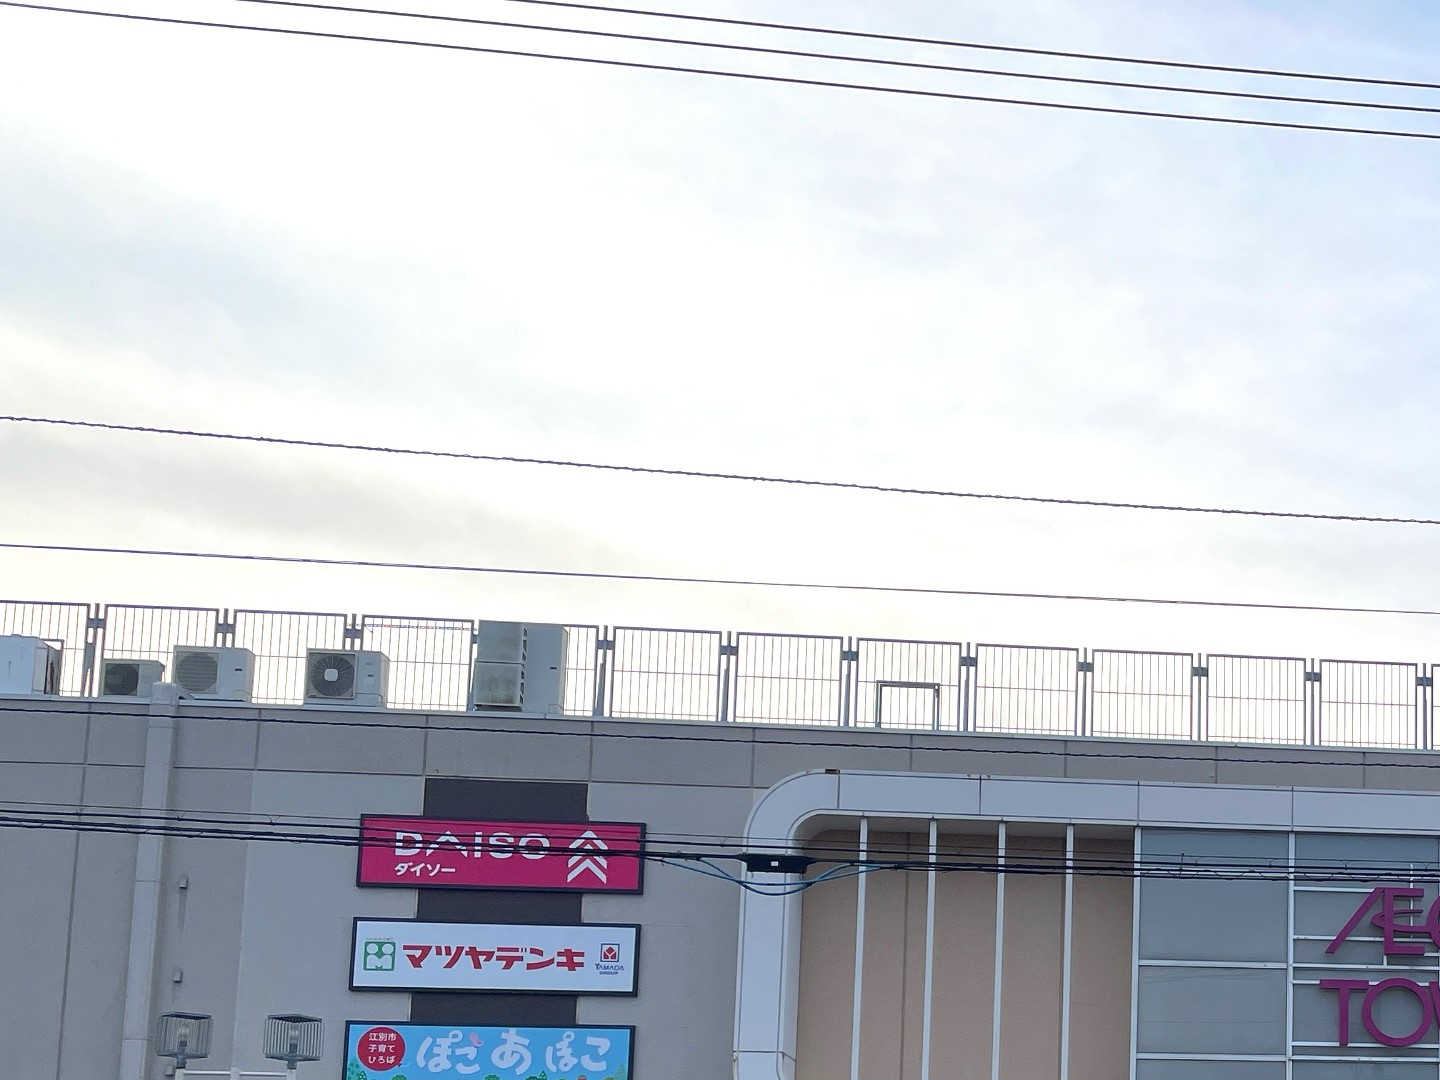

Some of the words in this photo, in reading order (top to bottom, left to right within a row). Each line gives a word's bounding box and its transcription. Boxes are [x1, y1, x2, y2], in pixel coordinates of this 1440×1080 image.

[394, 830, 550, 860] DAISO
[394, 862, 456, 877] ダイソー
[402, 944, 585, 972] マツヤデンキ
[595, 963, 624, 971] YAMADA
[368, 1032, 397, 1042] 江別市
[368, 1043, 396, 1053] 子育て
